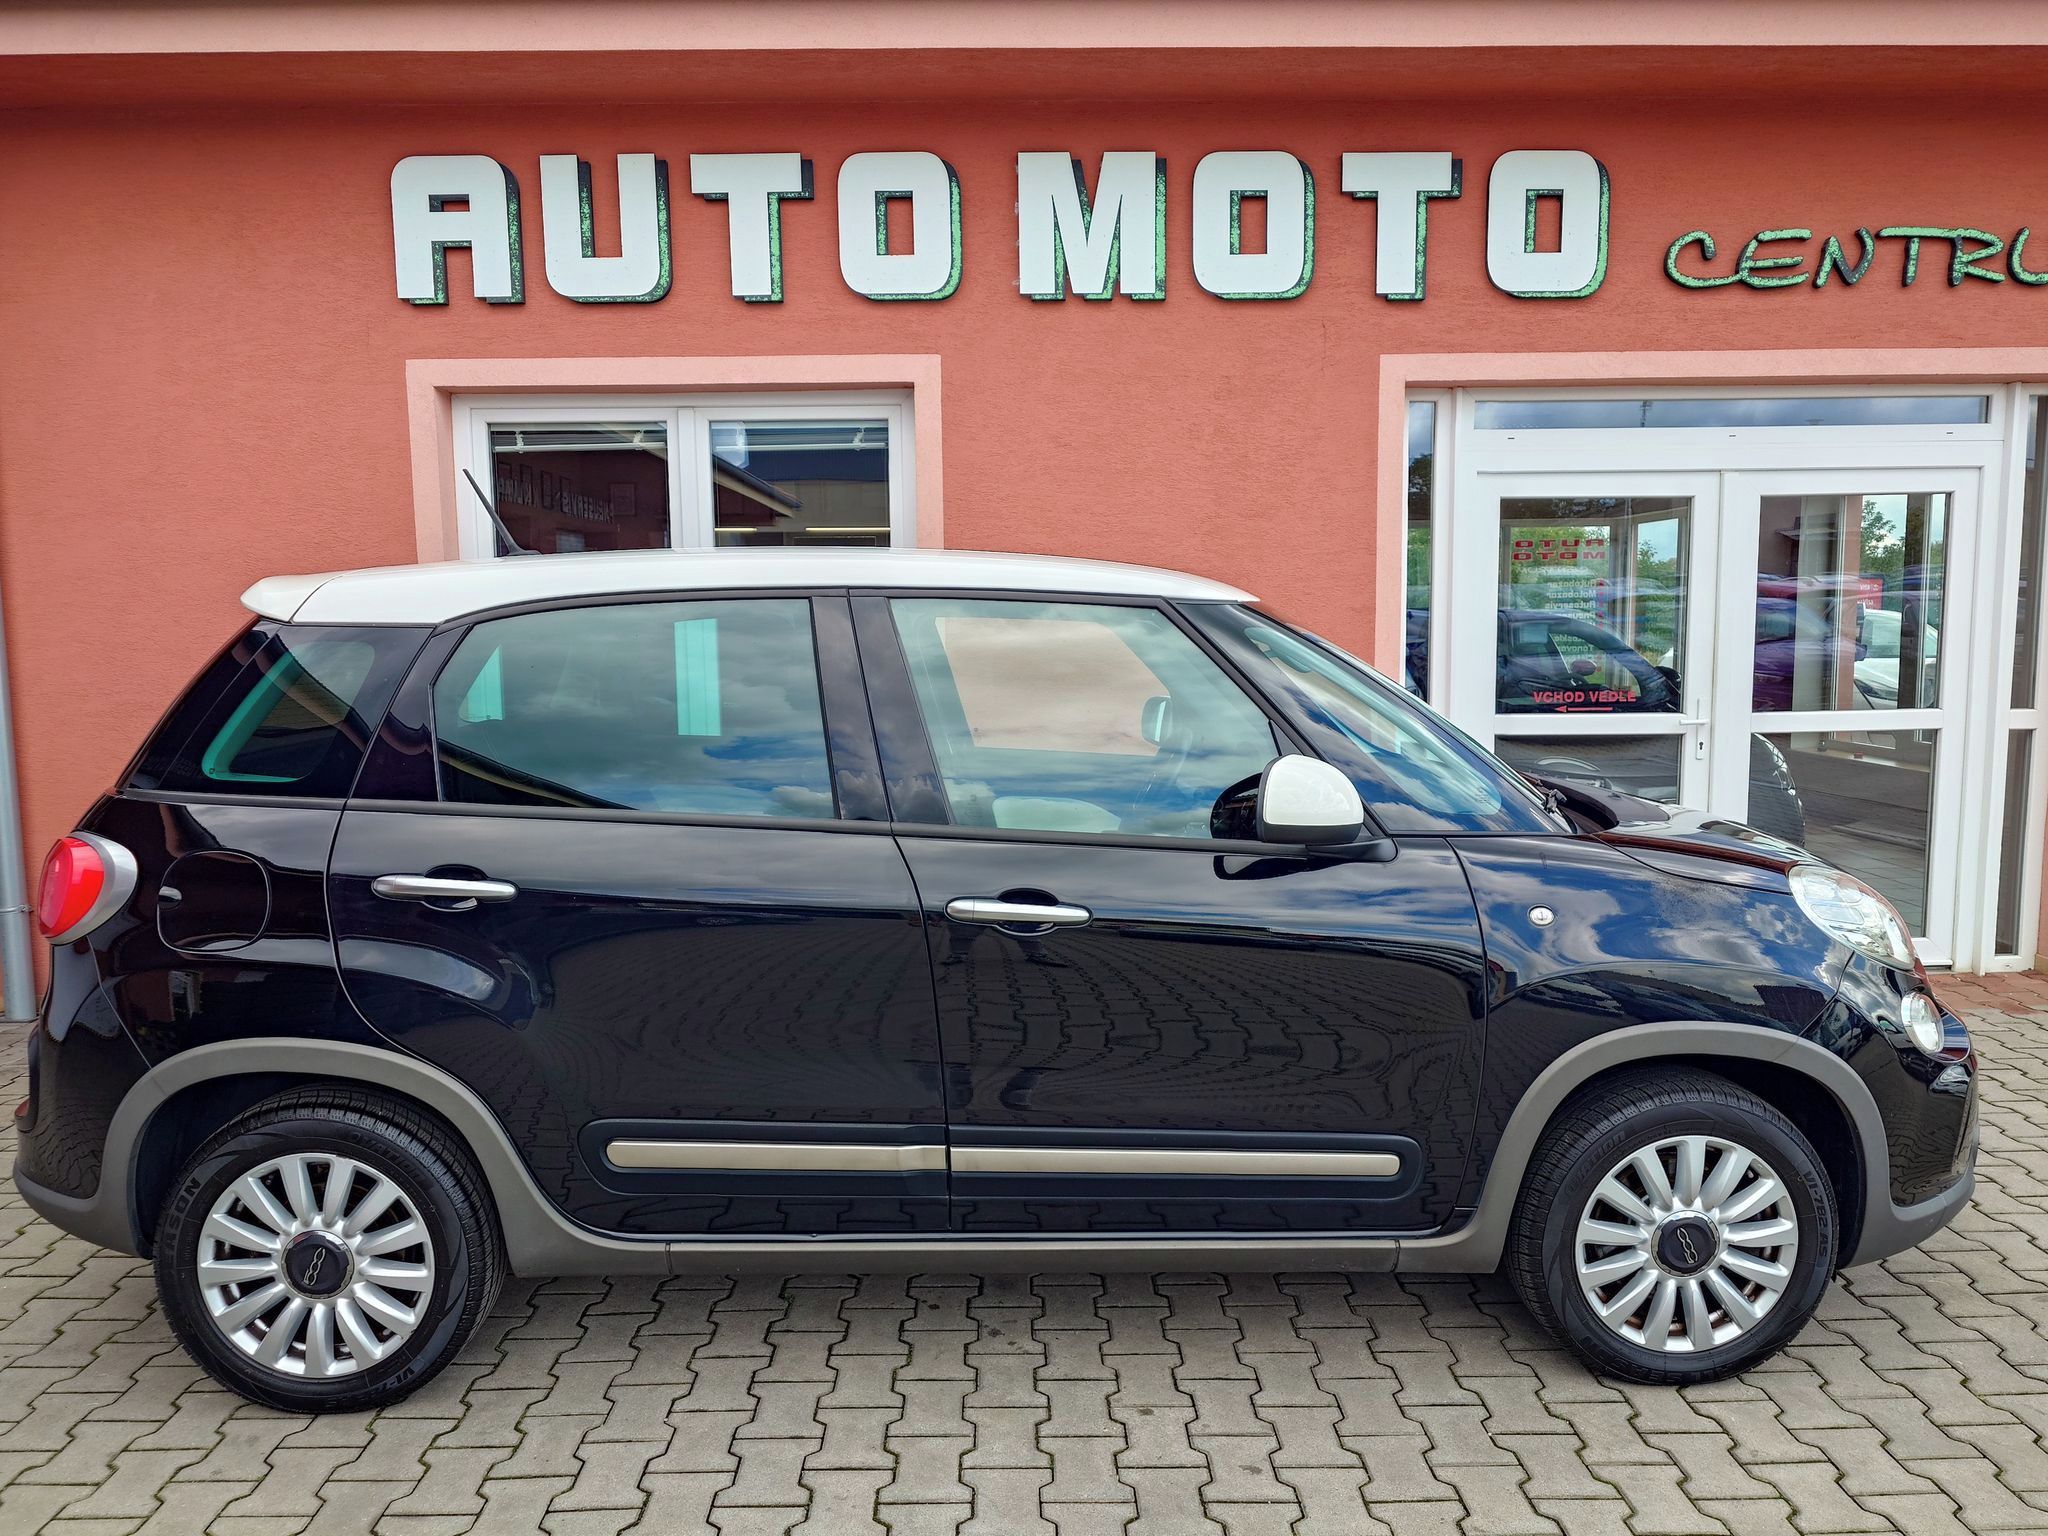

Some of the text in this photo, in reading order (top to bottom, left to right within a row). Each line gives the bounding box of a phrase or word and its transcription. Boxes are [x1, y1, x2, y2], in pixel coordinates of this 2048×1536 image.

[390, 151, 963, 305] AUTO
[1016, 149, 1611, 301] MOTO
[1533, 689, 1637, 703] VCHOD VEDLE
